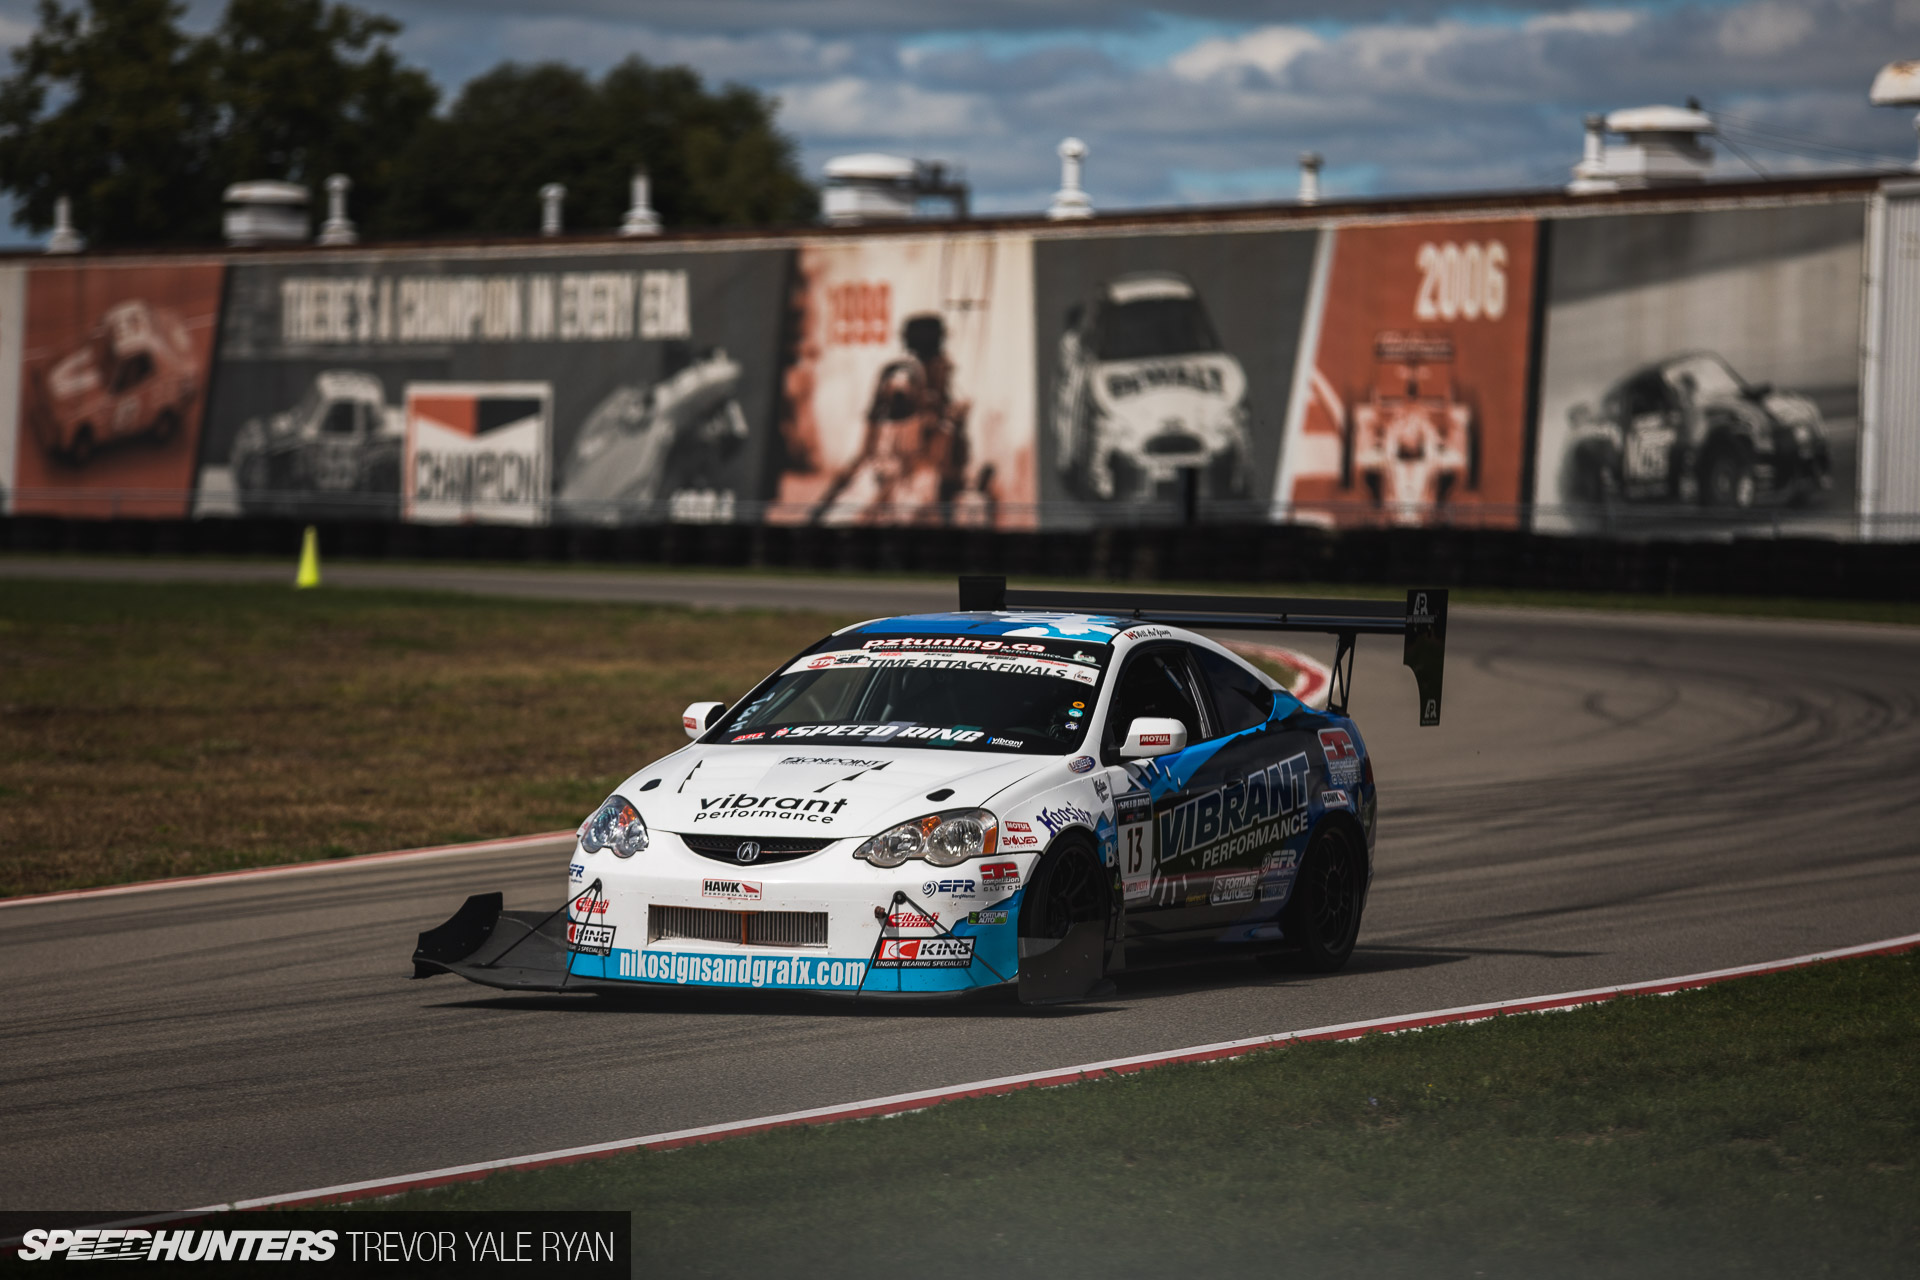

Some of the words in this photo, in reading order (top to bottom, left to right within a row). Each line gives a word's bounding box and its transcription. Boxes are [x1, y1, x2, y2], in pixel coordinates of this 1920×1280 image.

[1415, 239, 1509, 322] 2006
[400, 274, 521, 342] CHAMPION
[561, 272, 634, 339] EVERY
[640, 269, 692, 338] ERA
[416, 450, 541, 502] CHAMPION
[862, 636, 1046, 653] pztuning.ca
[1000, 648, 1061, 660] Performance
[869, 658, 921, 668] TIME
[921, 659, 994, 672] ATTACK
[996, 661, 1068, 678] FINALS
[785, 725, 899, 738] SPEED
[897, 726, 984, 743] RING
[700, 793, 848, 815] vibrant
[1322, 791, 1339, 804] HAWK
[1159, 751, 1310, 864] VIBRANT
[694, 808, 834, 825] performance
[1006, 821, 1030, 830] MOTUL
[1202, 811, 1309, 870] PERFORMANCE
[1127, 826, 1144, 874] 13
[1270, 848, 1297, 869] EFR
[704, 881, 741, 893] HAWK
[938, 879, 976, 893] EFR
[983, 877, 1020, 887] competition
[1224, 874, 1258, 890] FORTUNE
[1221, 889, 1240, 901] AUTO
[576, 897, 610, 912] Eibach
[888, 912, 940, 927] Eibach
[978, 911, 1008, 919] FORTUNE
[575, 928, 611, 943] KING
[920, 942, 971, 956] KING
[619, 949, 866, 988] nikosignsandgrafx.com
